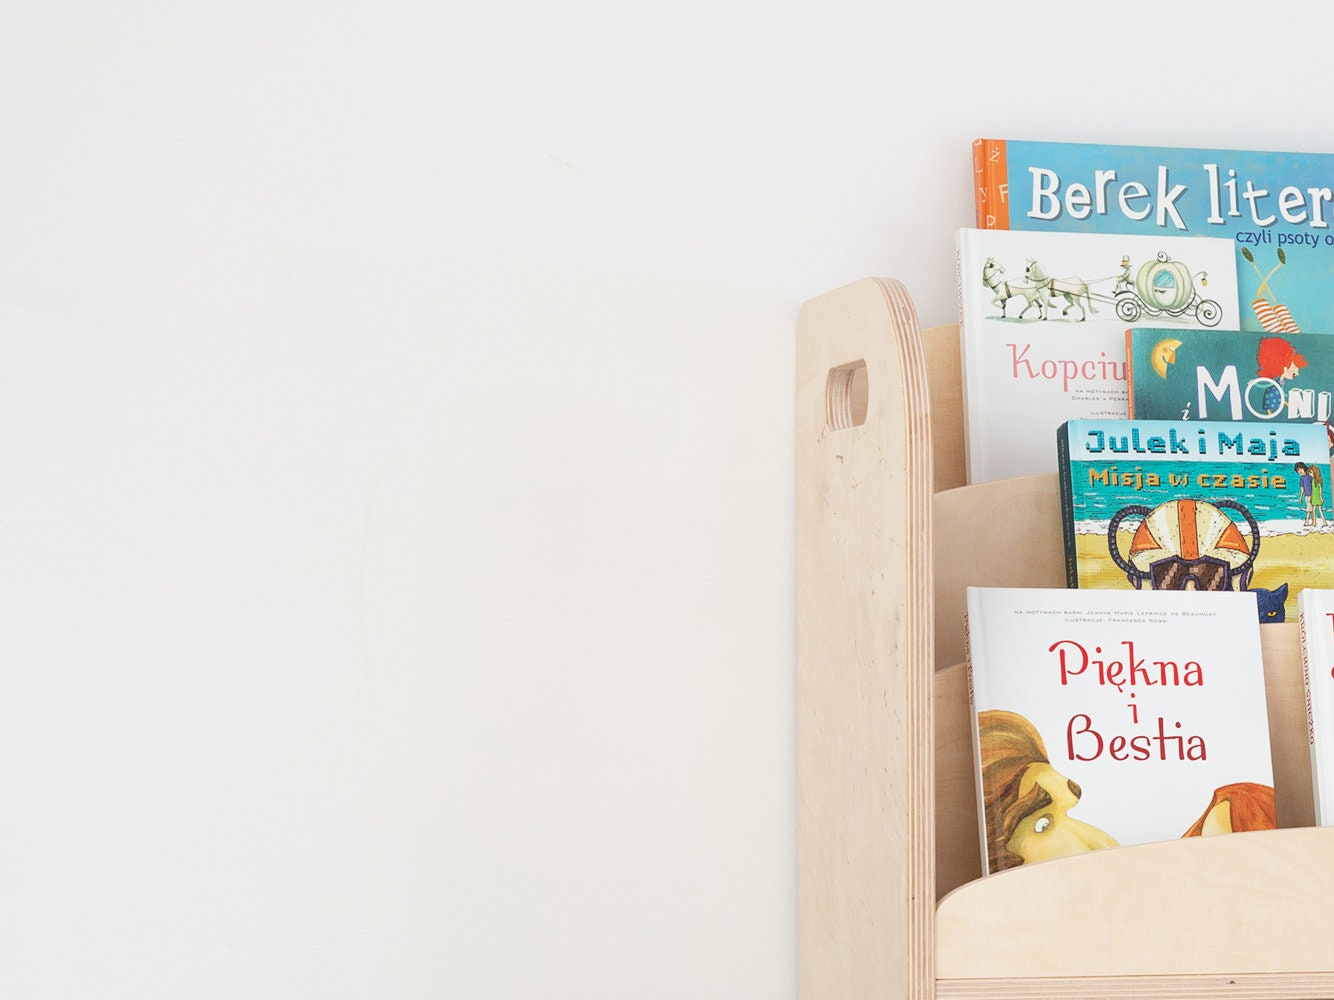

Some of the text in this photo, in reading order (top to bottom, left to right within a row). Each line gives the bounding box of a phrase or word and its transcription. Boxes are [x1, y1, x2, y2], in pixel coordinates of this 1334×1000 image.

[1027, 165, 1189, 231] Berek
[1235, 229, 1272, 248] czyli
[1278, 231, 1321, 249] psoty
[1086, 427, 1301, 461] Julek i Maja
[1088, 465, 1287, 492] Misja w czasie
[1049, 640, 1204, 693] Piękna
[1127, 692, 1139, 724] i
[1066, 713, 1207, 762] Bestia
